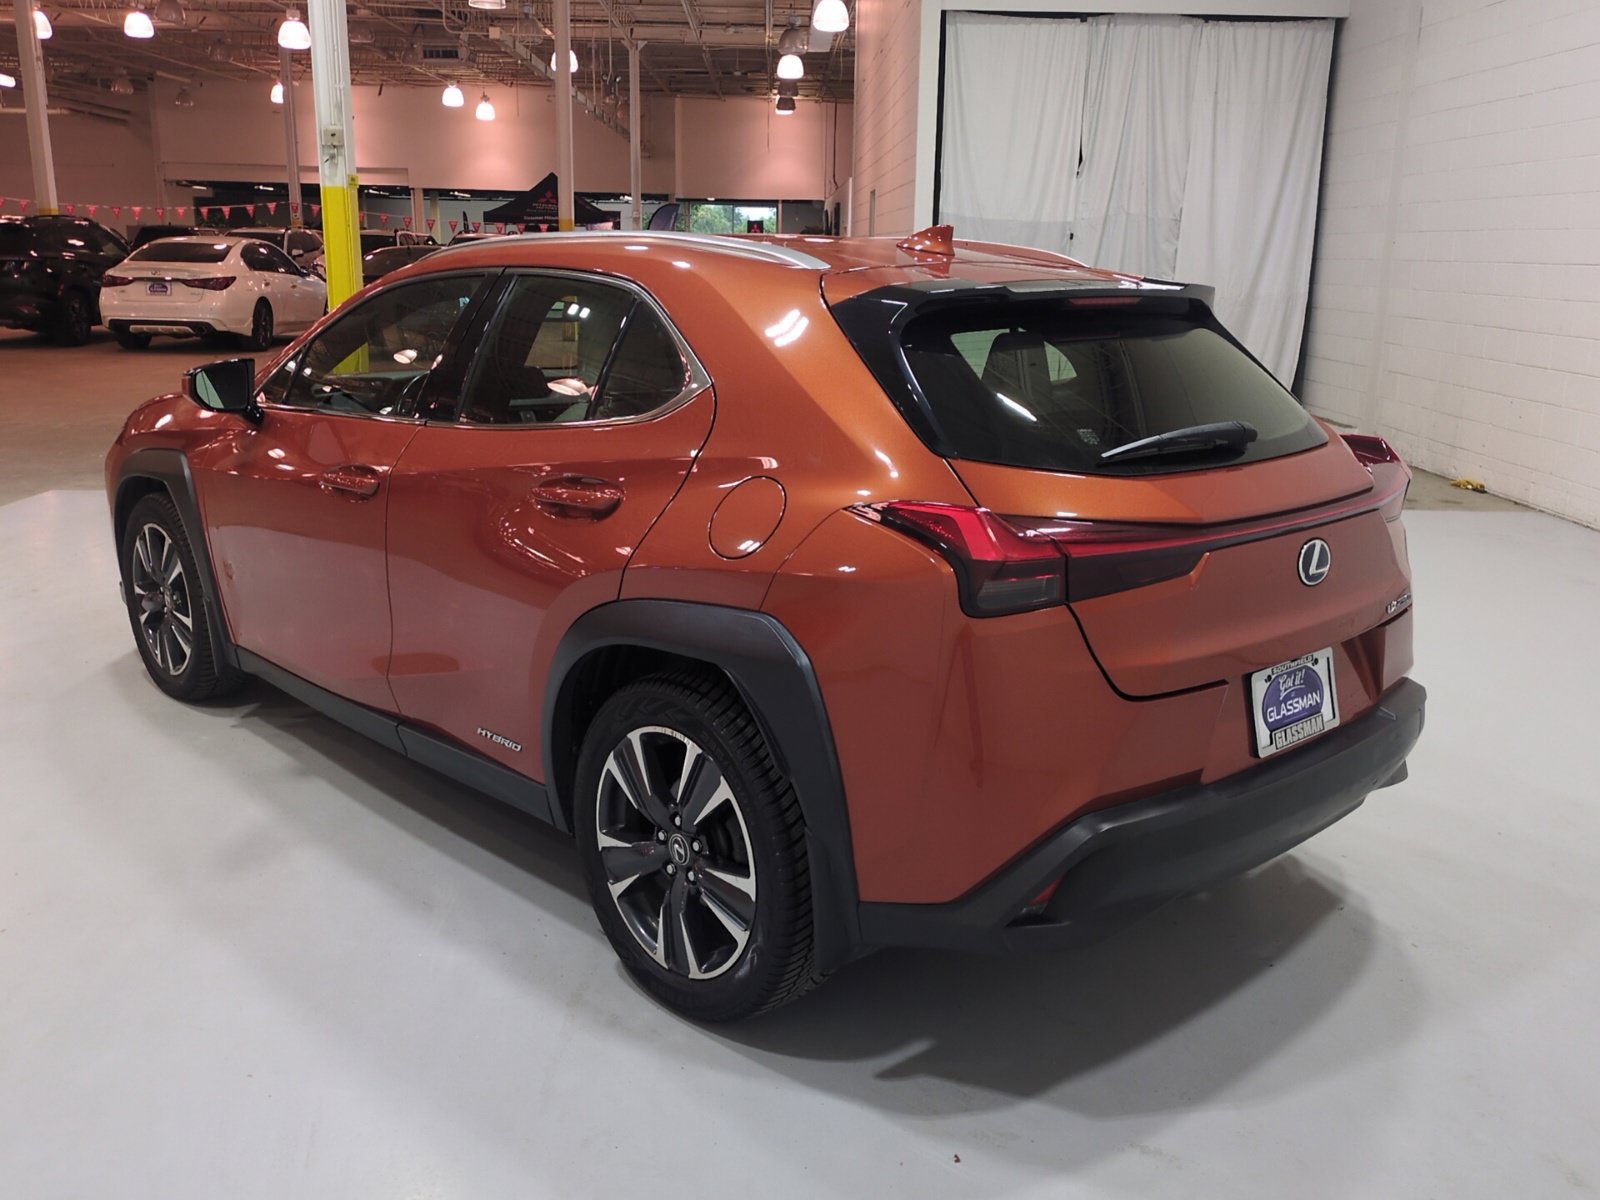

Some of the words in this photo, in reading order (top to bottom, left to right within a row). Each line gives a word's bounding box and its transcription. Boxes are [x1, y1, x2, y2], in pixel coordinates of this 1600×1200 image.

[1267, 690, 1321, 722] GLASSMAN
[477, 727, 521, 751] HYBRID
[1275, 716, 1323, 748] GLASSMAN
